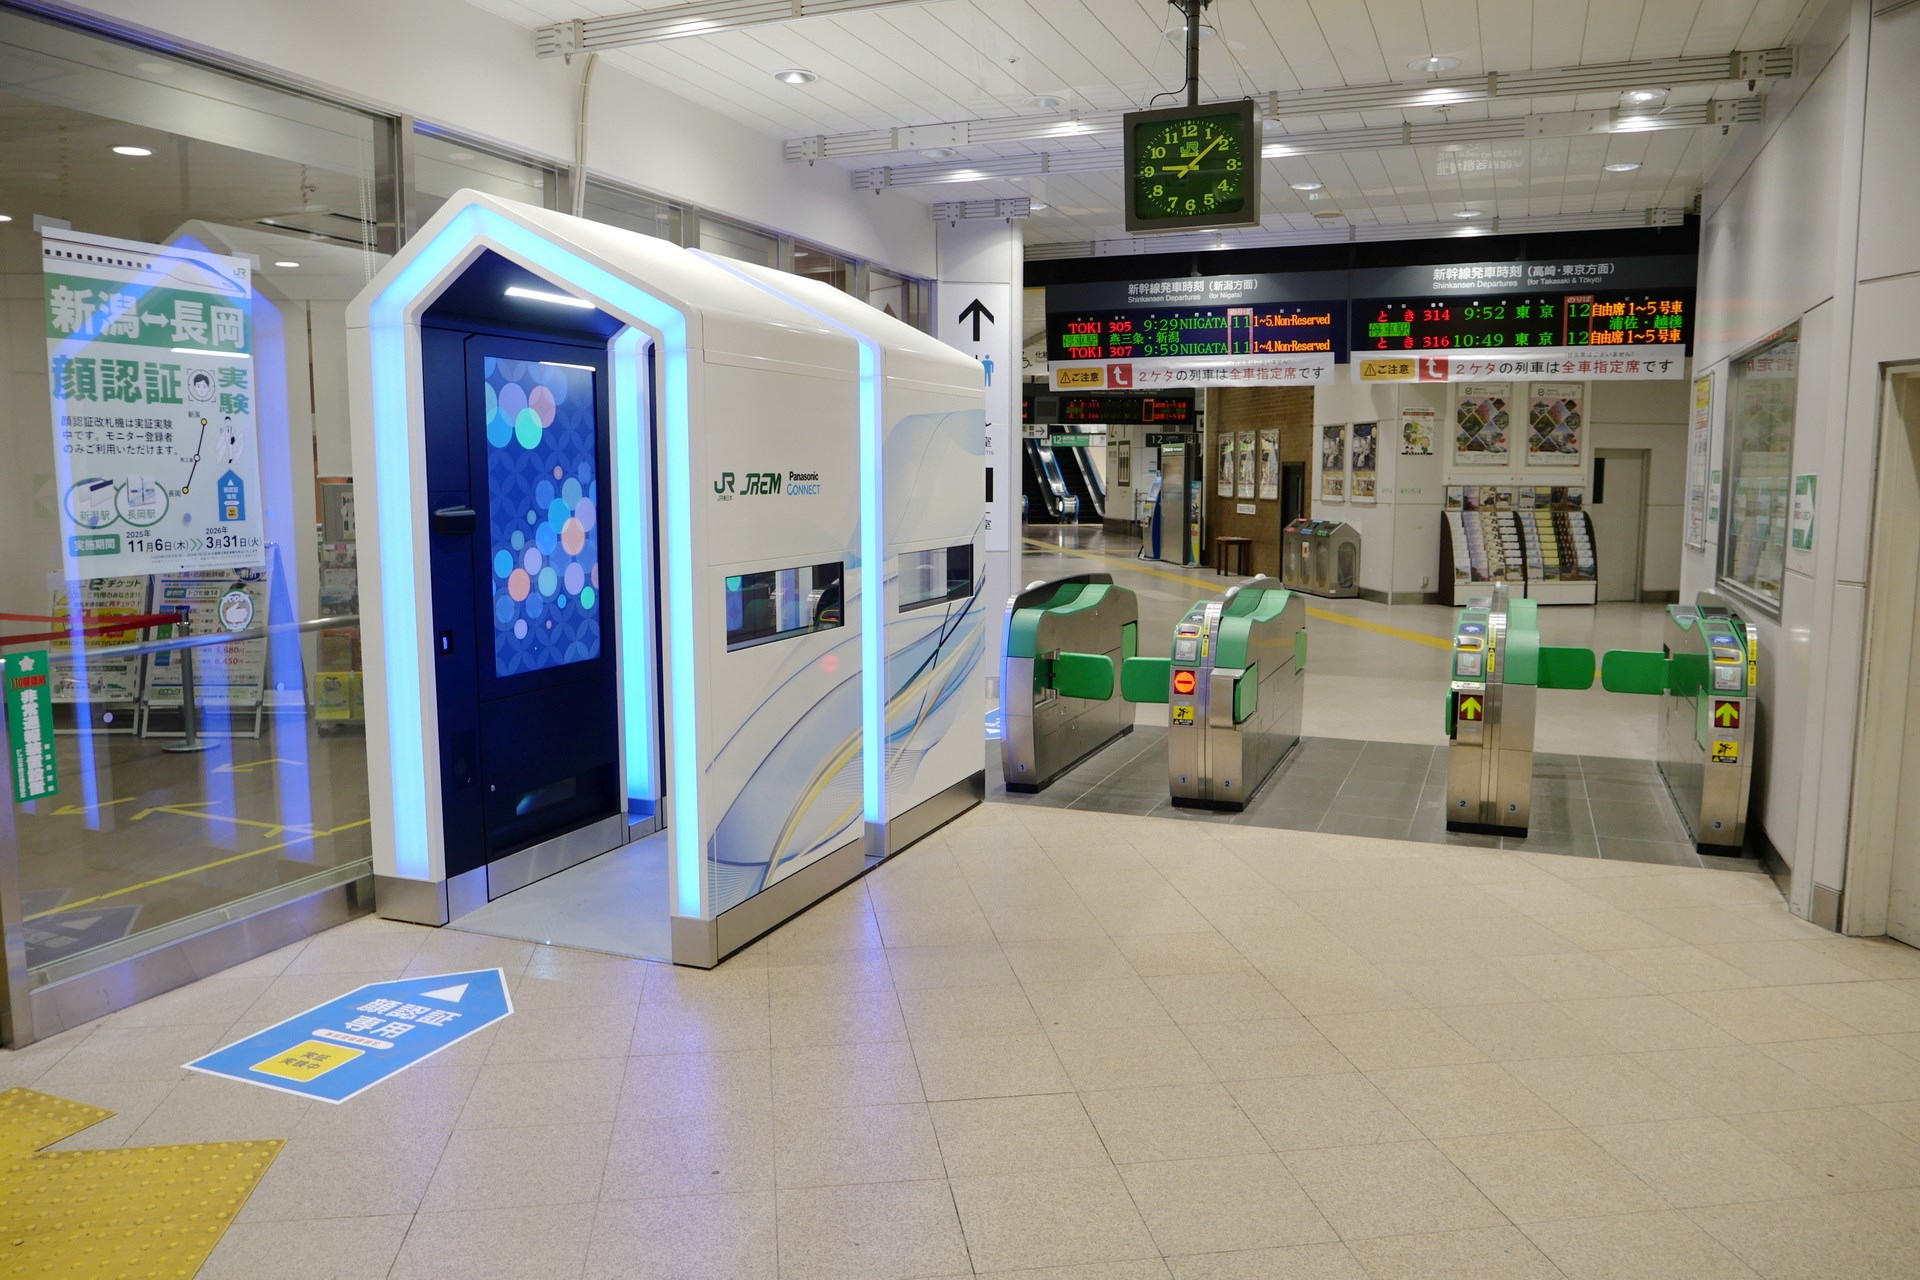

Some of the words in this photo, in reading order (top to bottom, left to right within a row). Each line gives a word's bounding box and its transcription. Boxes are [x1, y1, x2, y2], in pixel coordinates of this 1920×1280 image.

[1181, 125, 1198, 138] 12
[1205, 128, 1212, 140] 1
[1164, 132, 1179, 145] 11
[1218, 138, 1229, 151] 2
[1151, 146, 1166, 159] 10
[1226, 158, 1237, 171] 3
[1144, 166, 1155, 178] 9
[1152, 185, 1163, 197] 8
[1217, 179, 1229, 191] 4
[1168, 196, 1178, 208] 7
[1185, 199, 1196, 211] 6
[1203, 193, 1214, 206] 5
[1432, 280, 1474, 290] Shinkansen
[1476, 278, 1518, 288] Departures
[1527, 278, 1539, 287] (for
[1541, 277, 1570, 285] Takasaki
[1128, 294, 1164, 303] Shinkansen
[1165, 292, 1201, 301] Departures
[1220, 291, 1243, 299] Niigata)
[50, 284, 140, 339] 新潟
[170, 300, 246, 350] 長岡
[1423, 309, 1450, 322] 314
[1464, 306, 1505, 321] 9:52
[1569, 303, 1591, 318] 12
[1068, 322, 1102, 334] TOKI
[1109, 321, 1132, 333] 305
[1143, 318, 1178, 332] 9:29
[1179, 316, 1228, 330] NIIGATA
[1109, 331, 1180, 345] 燕三条・新潟
[1422, 336, 1450, 348] 316
[1454, 333, 1504, 347] 10:49
[1568, 331, 1589, 345] 12
[1069, 347, 1102, 359] TOKI
[1109, 346, 1133, 357] 307
[1144, 343, 1178, 357] 9:59
[1180, 341, 1229, 356] NIIGATA
[1378, 363, 1410, 375] ご注意
[51, 353, 183, 405] 顔認証
[1072, 372, 1099, 383] ご注意
[218, 366, 250, 415] 実験
[61, 416, 173, 430] 顔認証改札機は実証実験
[63, 444, 178, 456] のみご利用いただけます。
[789, 471, 819, 481] Panasonic
[714, 472, 735, 494] JR
[740, 473, 782, 495] JREM
[127, 509, 156, 520] 長岡駅
[126, 530, 151, 539] 2025年
[205, 526, 229, 535] 2026年
[128, 537, 189, 554] 11月6日(木)
[206, 535, 262, 551] 3月31日(火)
[356, 998, 462, 1027] 顔認証
[344, 1015, 416, 1039] 専用
